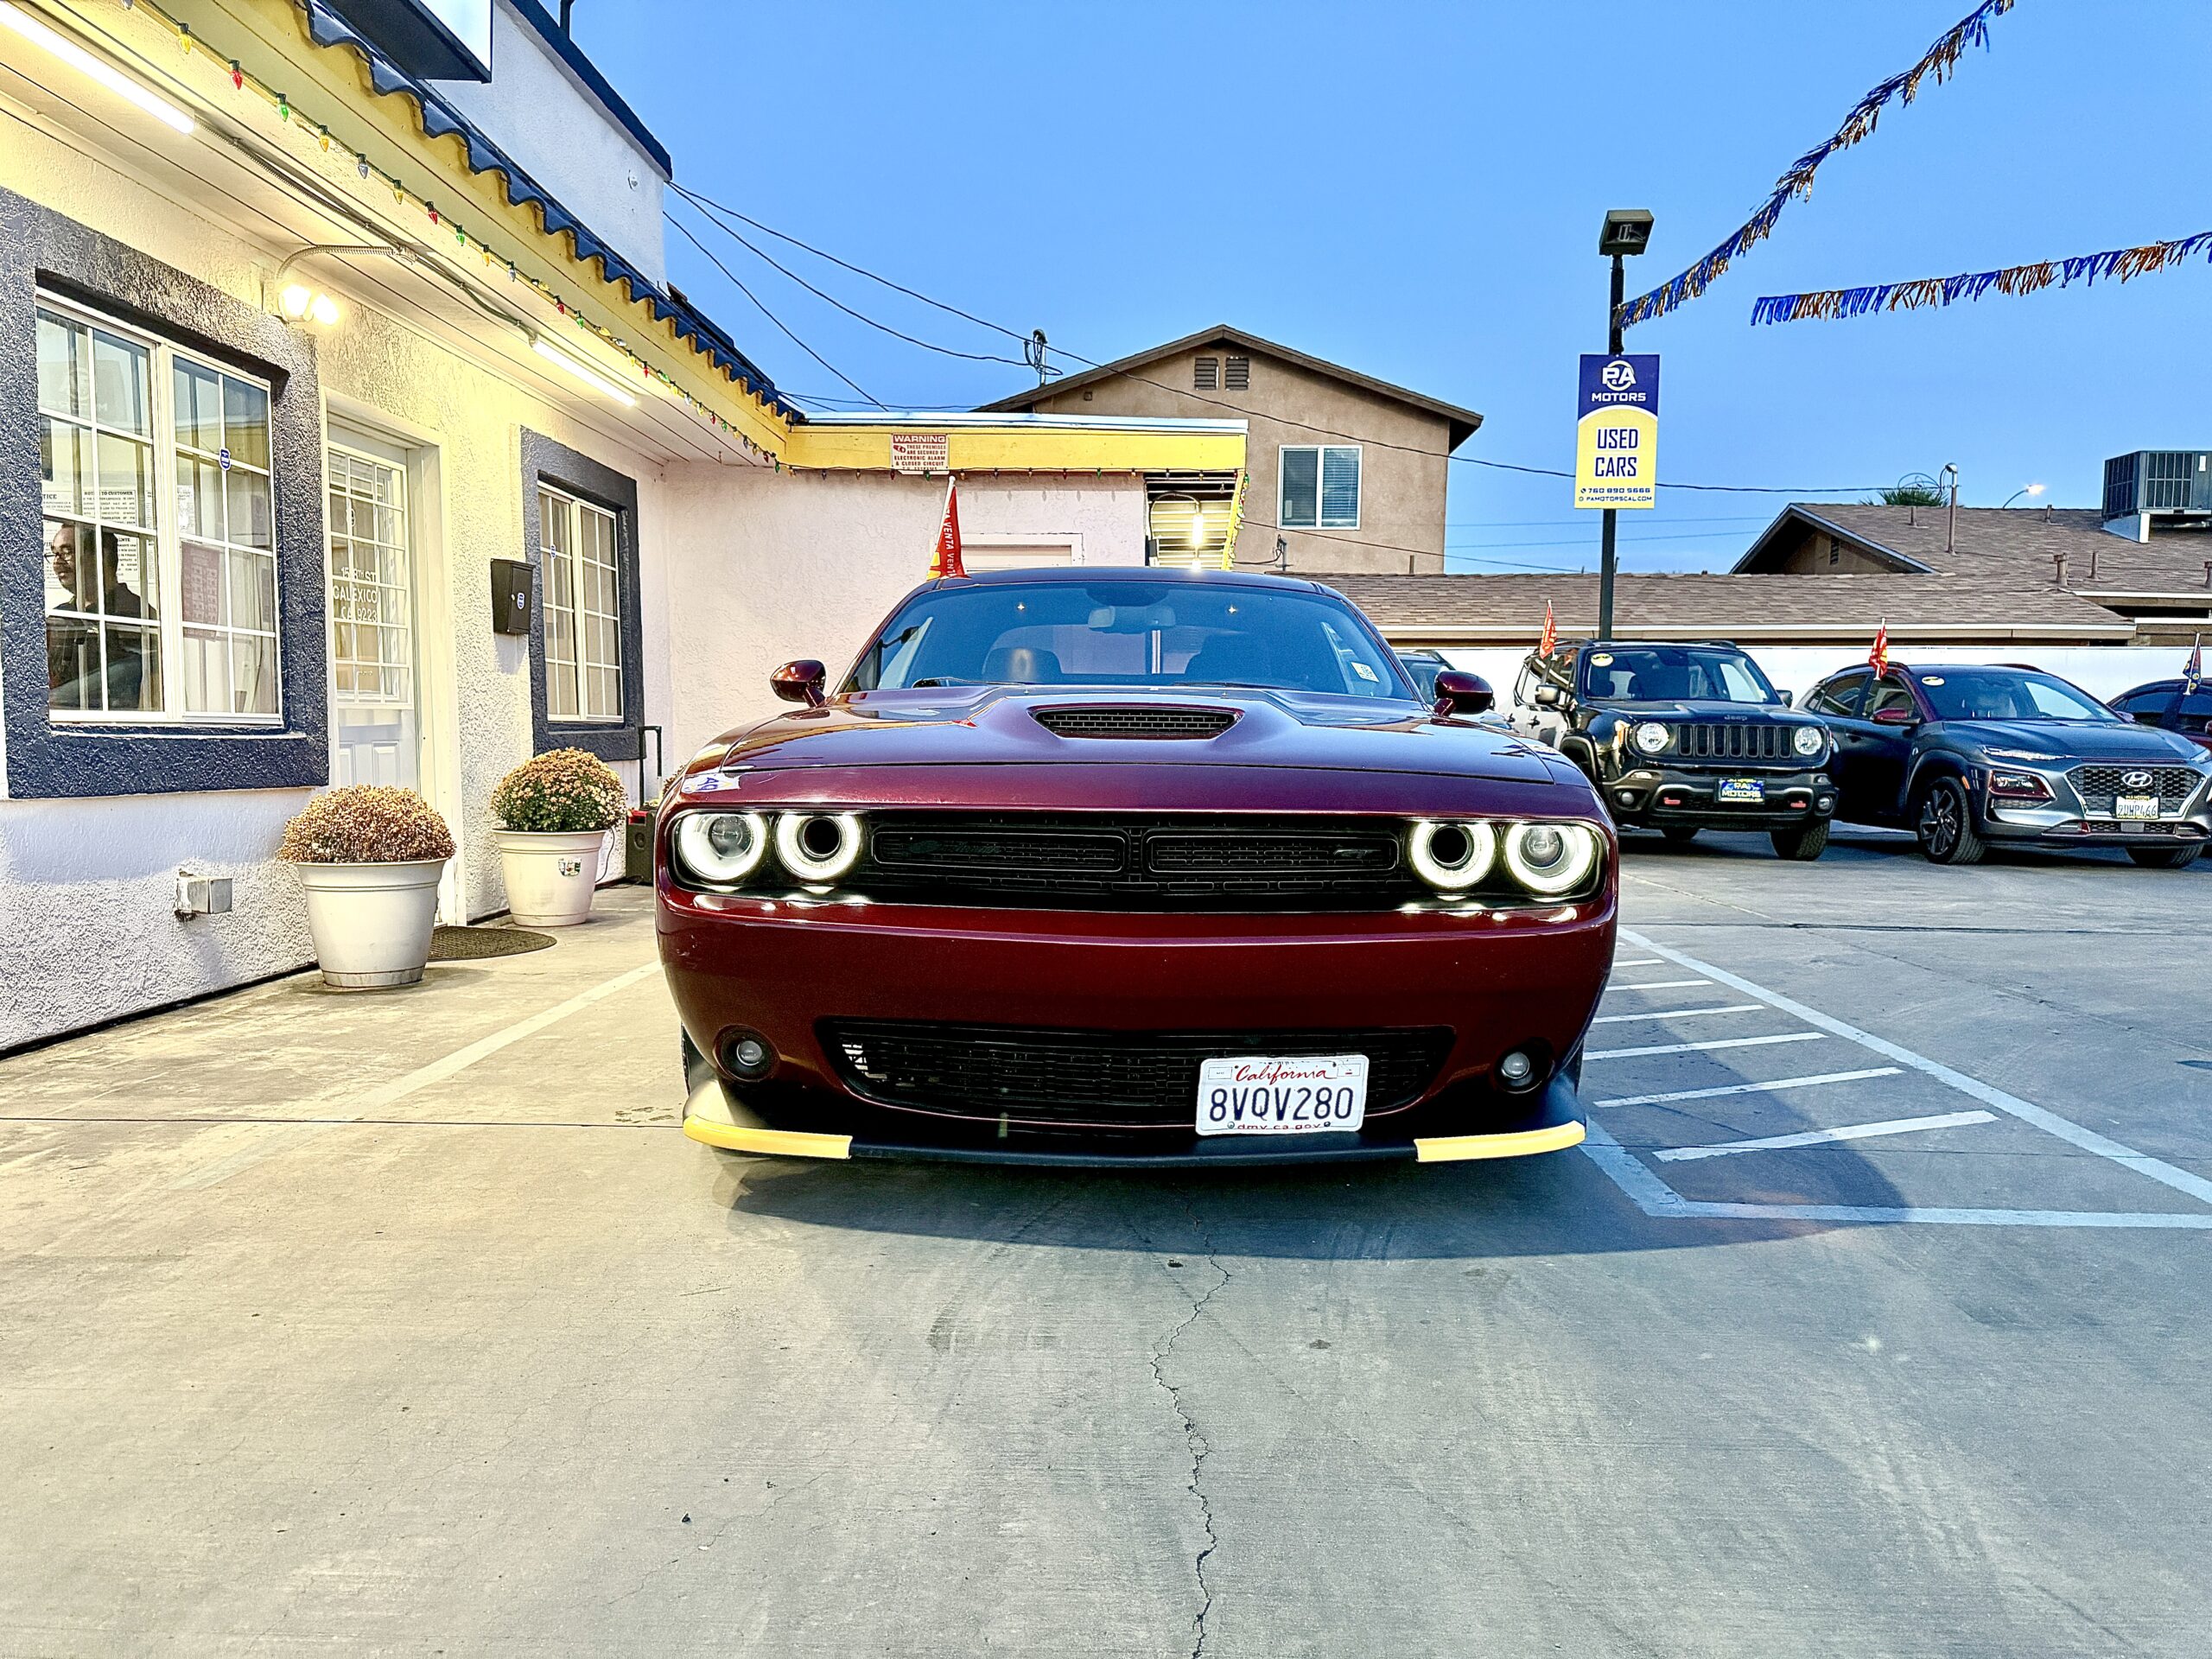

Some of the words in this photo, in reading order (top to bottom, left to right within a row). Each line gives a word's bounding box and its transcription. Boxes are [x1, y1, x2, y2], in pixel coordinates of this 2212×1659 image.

[1591, 392, 1647, 402] MOTORS
[1597, 429, 1638, 448] USED
[1594, 456, 1637, 477] CARS
[943, 522, 955, 550] VENTA
[334, 585, 378, 604] CALEXICO
[1235, 1065, 1338, 1085] California
[1209, 1086, 1354, 1122] 8VQV280
